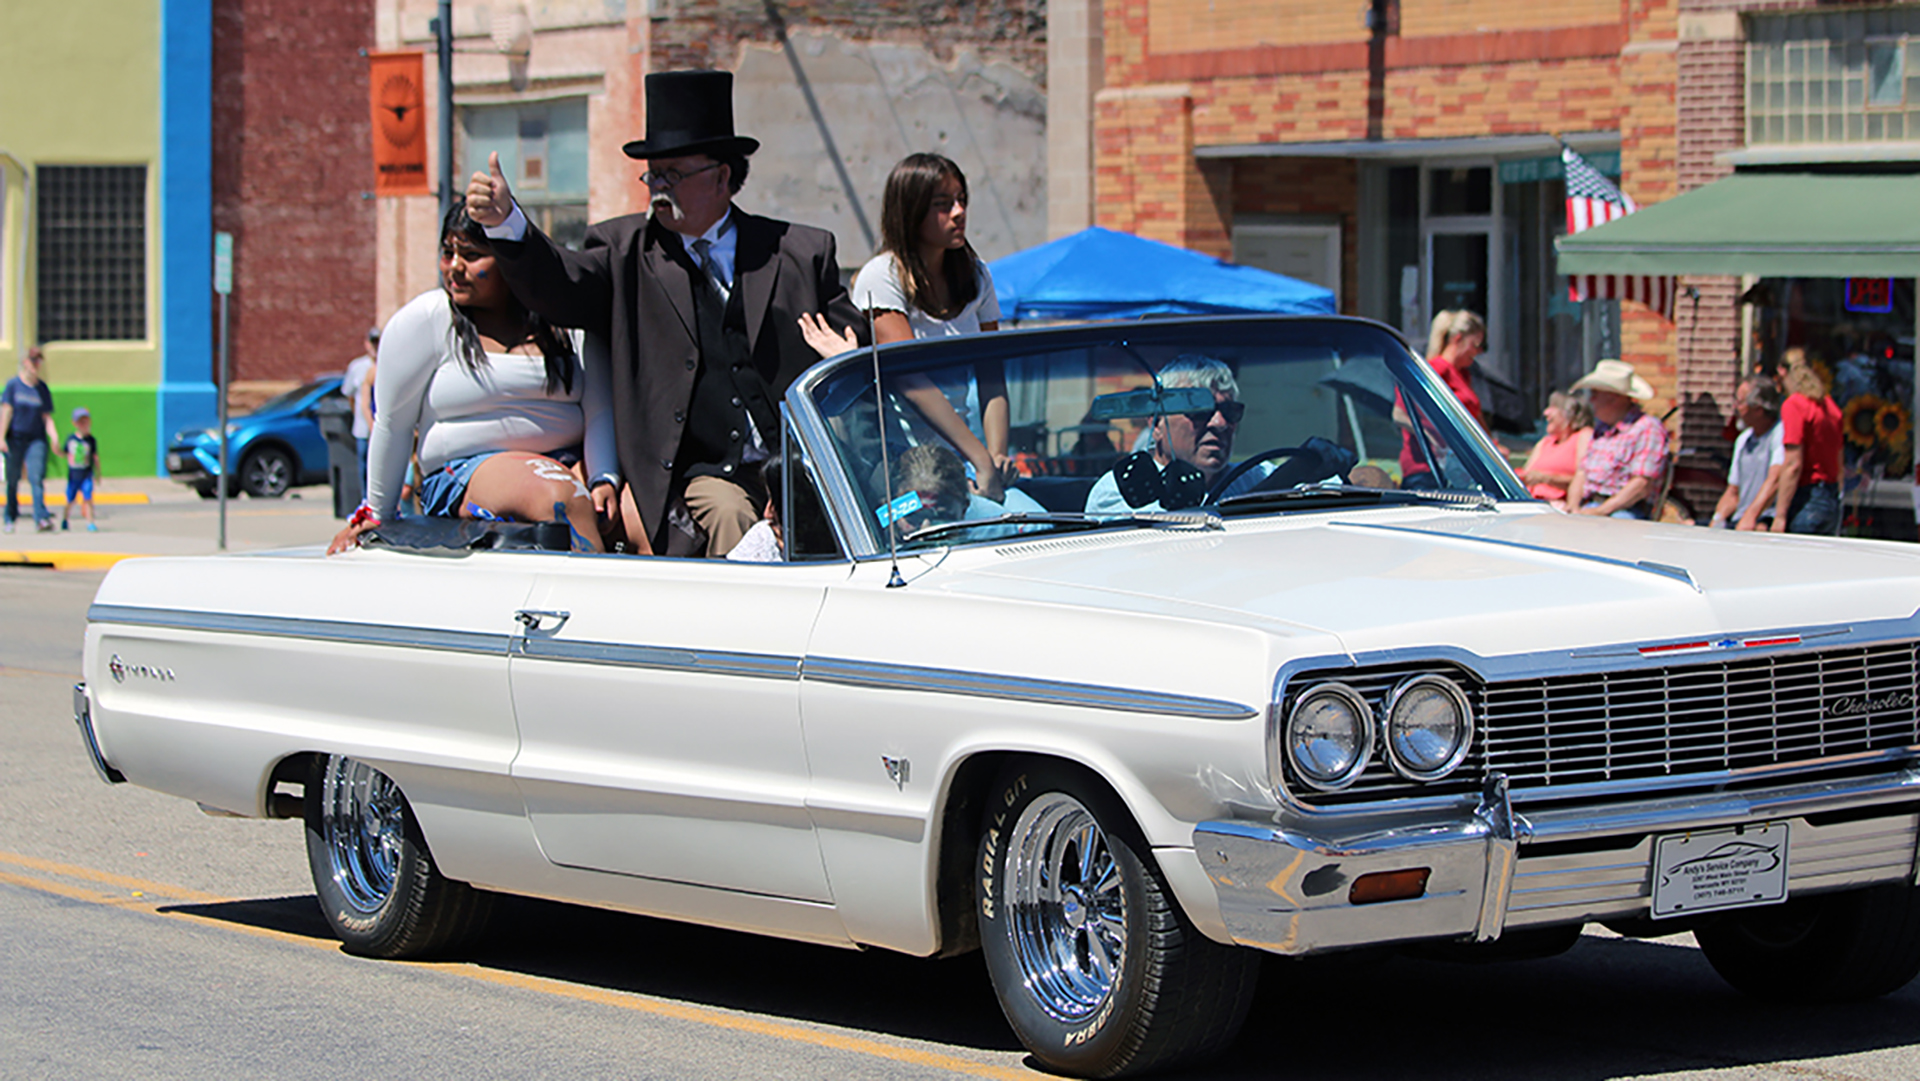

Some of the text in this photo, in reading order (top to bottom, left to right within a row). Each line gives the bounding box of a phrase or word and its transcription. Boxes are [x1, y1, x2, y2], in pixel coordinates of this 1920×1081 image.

[982, 812, 1006, 919] RADIAL
[1683, 859, 1759, 875] Andy's Service Company
[1064, 995, 1114, 1047] COBRA
